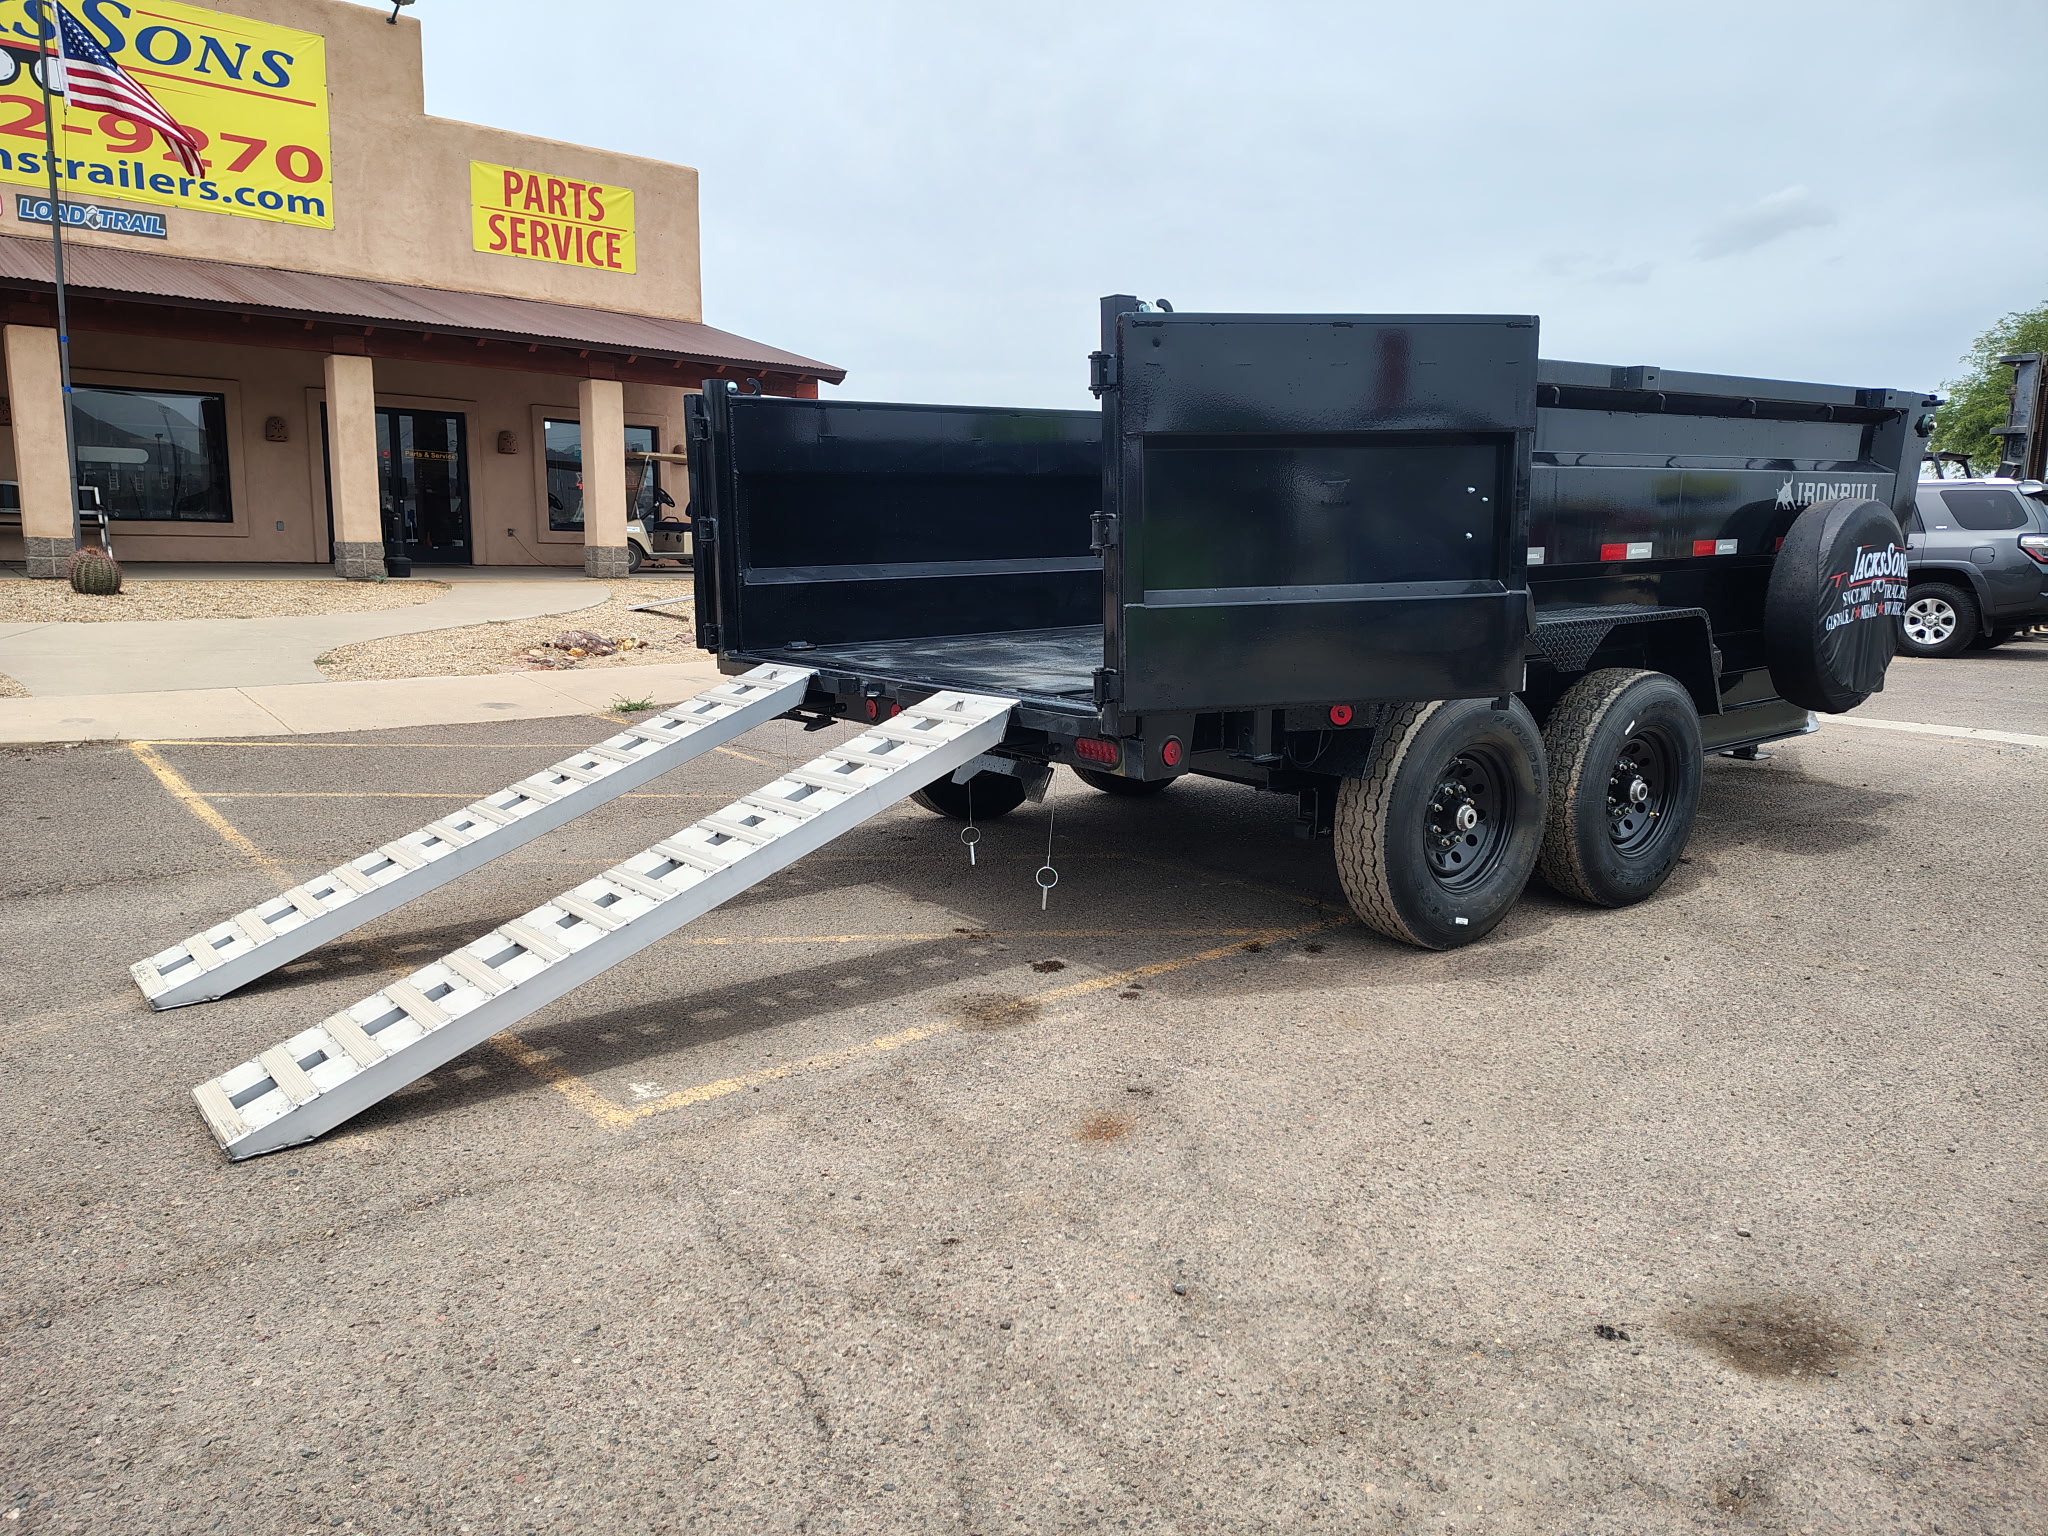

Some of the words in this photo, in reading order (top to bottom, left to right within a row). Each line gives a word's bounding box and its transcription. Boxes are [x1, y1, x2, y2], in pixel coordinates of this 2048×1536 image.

[19, 198, 87, 225] LOAD
[97, 209, 166, 236] TRAIL
[503, 170, 605, 222] PARTS
[488, 213, 622, 269] SERVICE
[404, 450, 422, 458] Parts
[431, 452, 456, 460] Service
